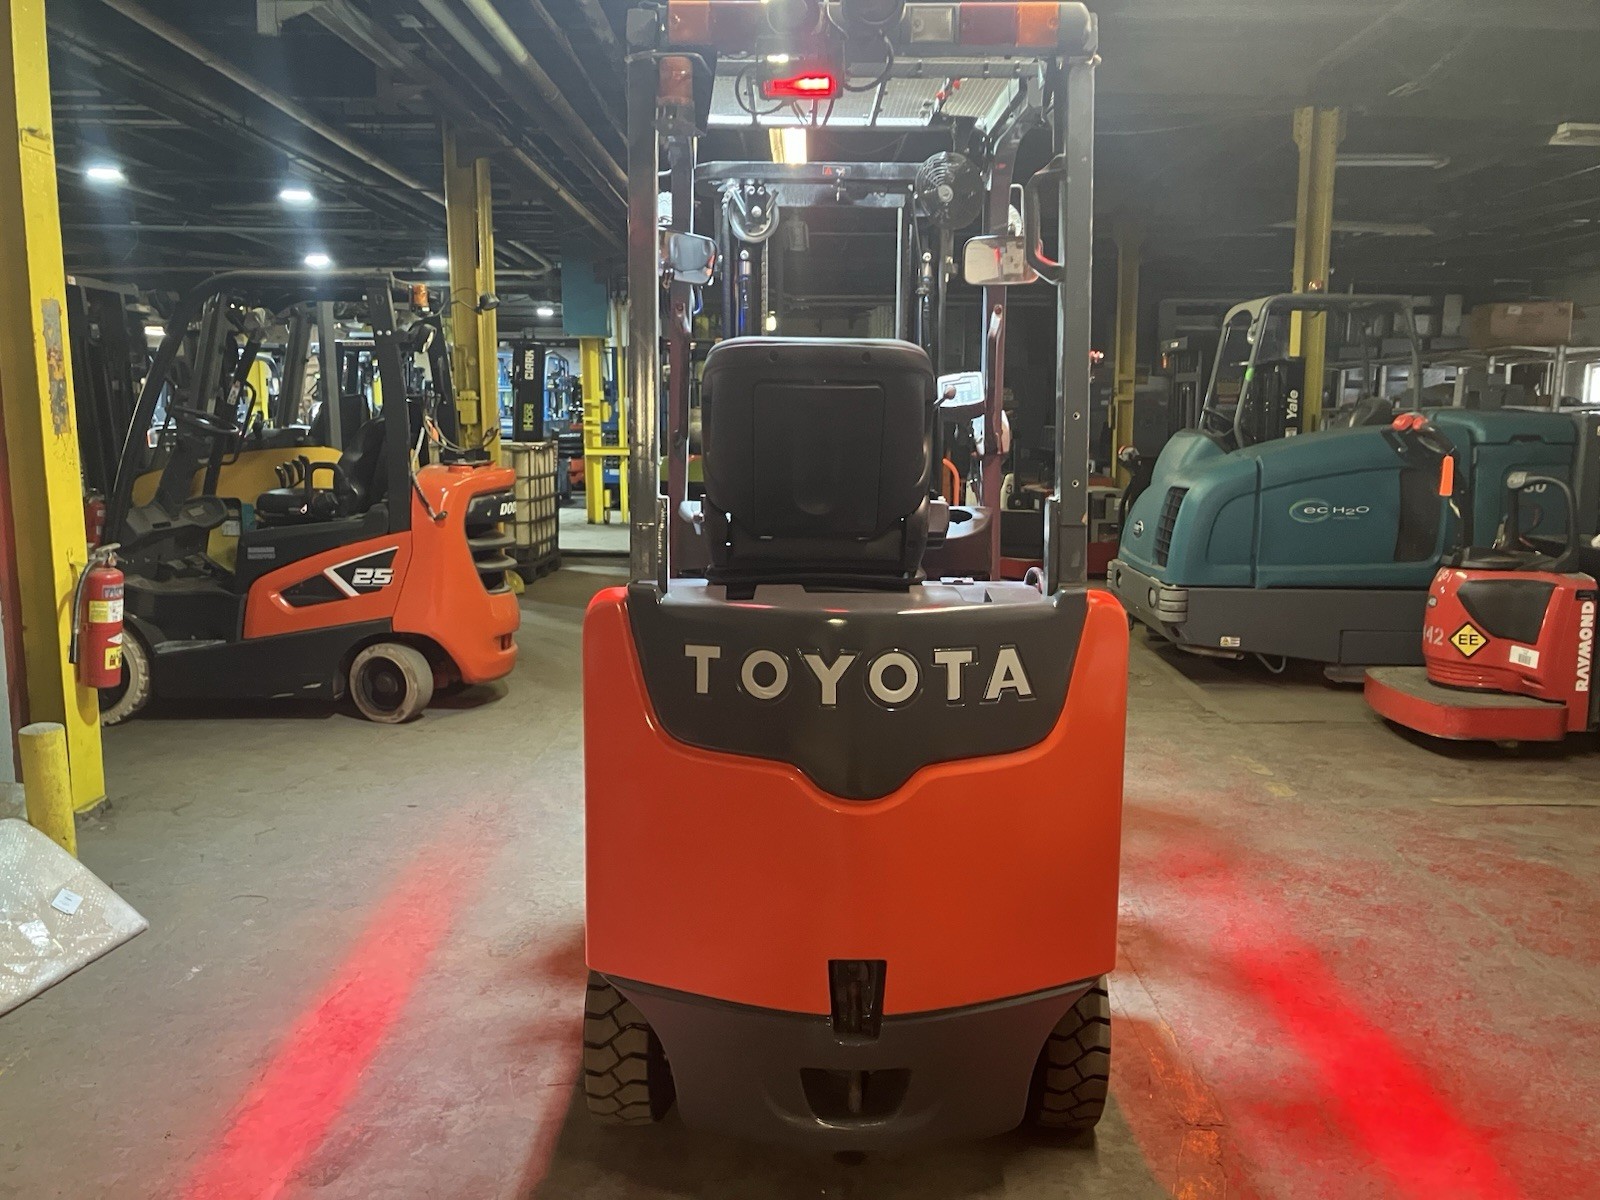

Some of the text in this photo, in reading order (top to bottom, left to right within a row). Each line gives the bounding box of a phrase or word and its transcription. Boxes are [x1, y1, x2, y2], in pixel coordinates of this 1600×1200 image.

[524, 349, 534, 380] CLARK
[1286, 389, 1299, 420] Yale
[1332, 505, 1370, 516] H2O
[351, 567, 394, 587] 25
[1458, 634, 1479, 645] EE
[1575, 600, 1595, 692] RAYMOND
[684, 644, 1033, 705] TOYOTA
